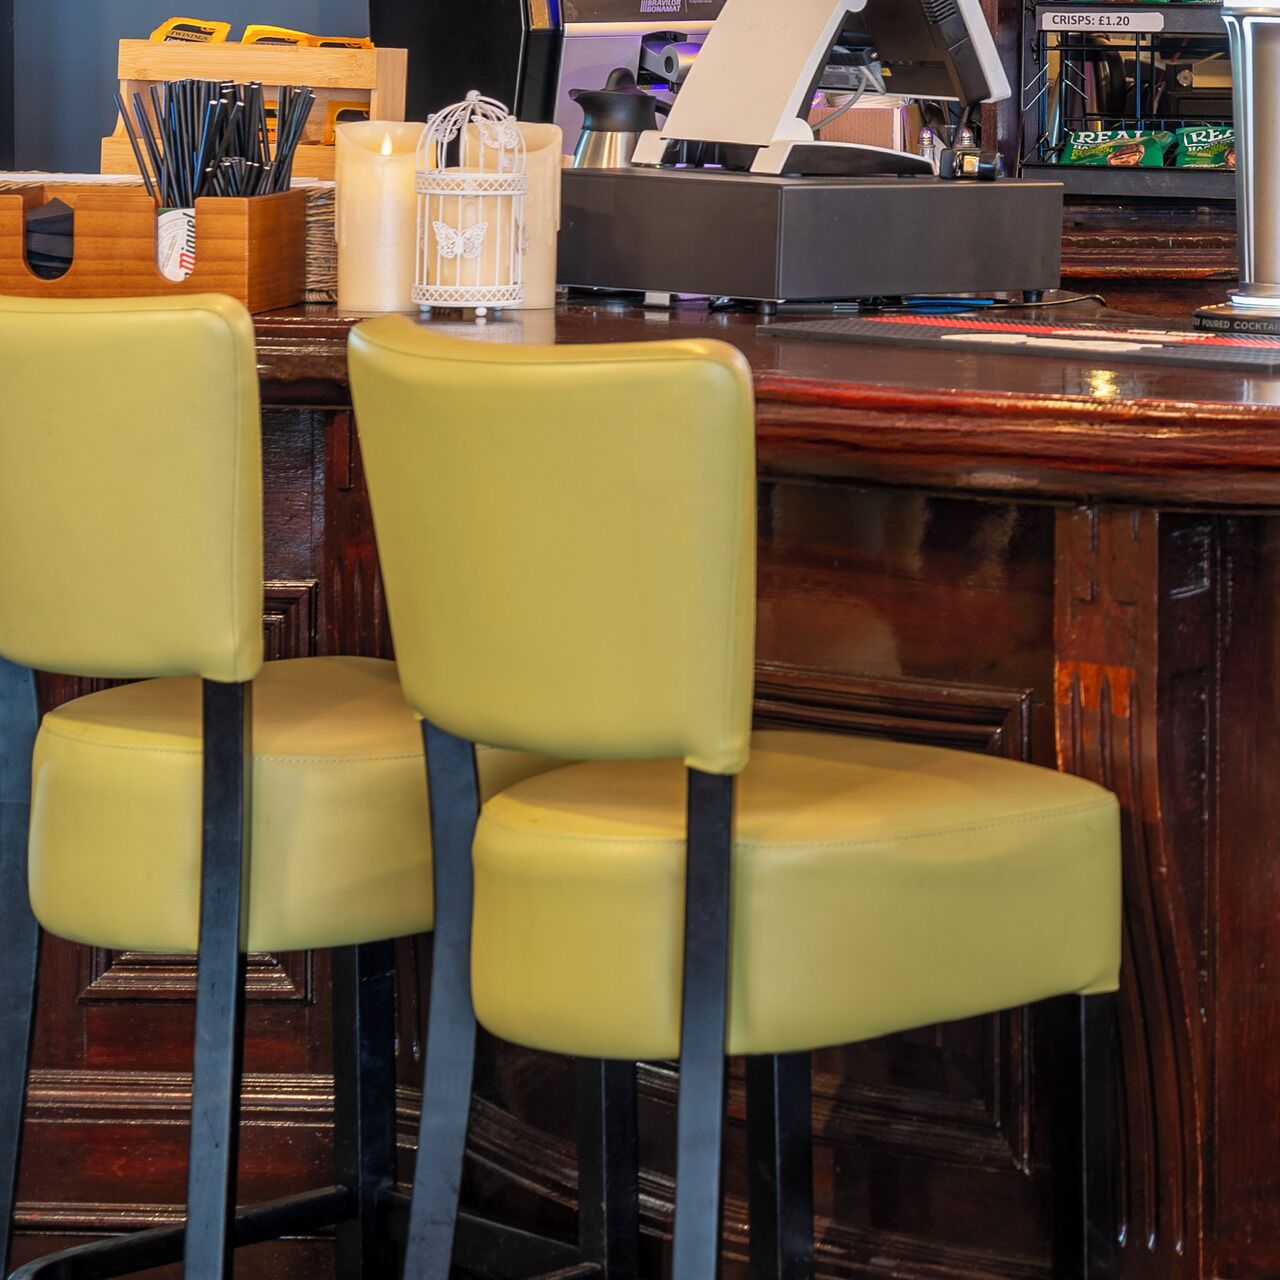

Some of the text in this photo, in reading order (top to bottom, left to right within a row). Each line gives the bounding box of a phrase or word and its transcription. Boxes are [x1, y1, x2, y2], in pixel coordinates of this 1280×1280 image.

[1052, 14, 1130, 26] CRISPS: £1.20
[171, 31, 209, 41] TWININGS
[1202, 319, 1230, 329] POURED
